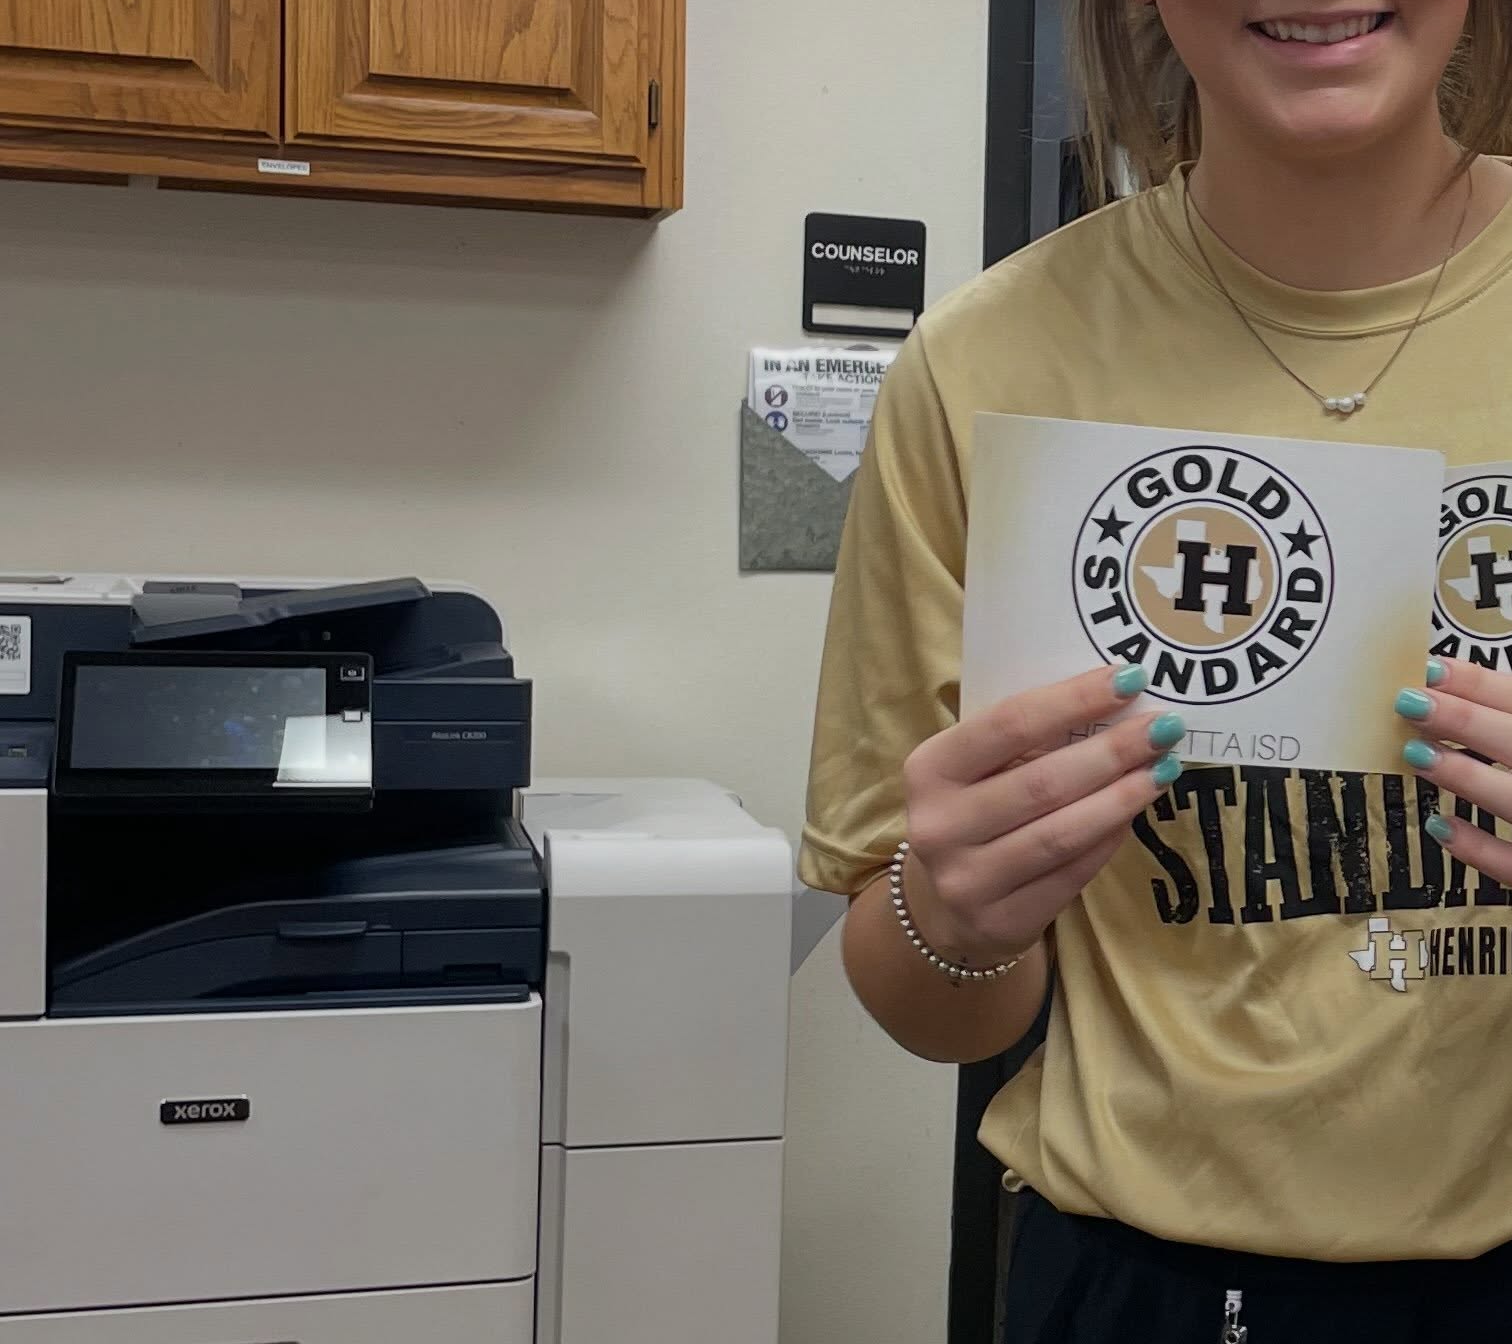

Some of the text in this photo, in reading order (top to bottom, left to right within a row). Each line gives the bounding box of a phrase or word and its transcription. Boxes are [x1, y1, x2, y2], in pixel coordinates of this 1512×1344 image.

[811, 242, 919, 266] COUNSELOR
[764, 358, 889, 375] IN AN EMERGE
[838, 373, 883, 385] ACTION
[1127, 454, 1291, 520] GOLD
[1174, 540, 1257, 616] H
[1083, 555, 1324, 696] STANDARD
[1251, 733, 1301, 762] ISD
[1370, 929, 1425, 980] H
[174, 1102, 235, 1120] xerox
